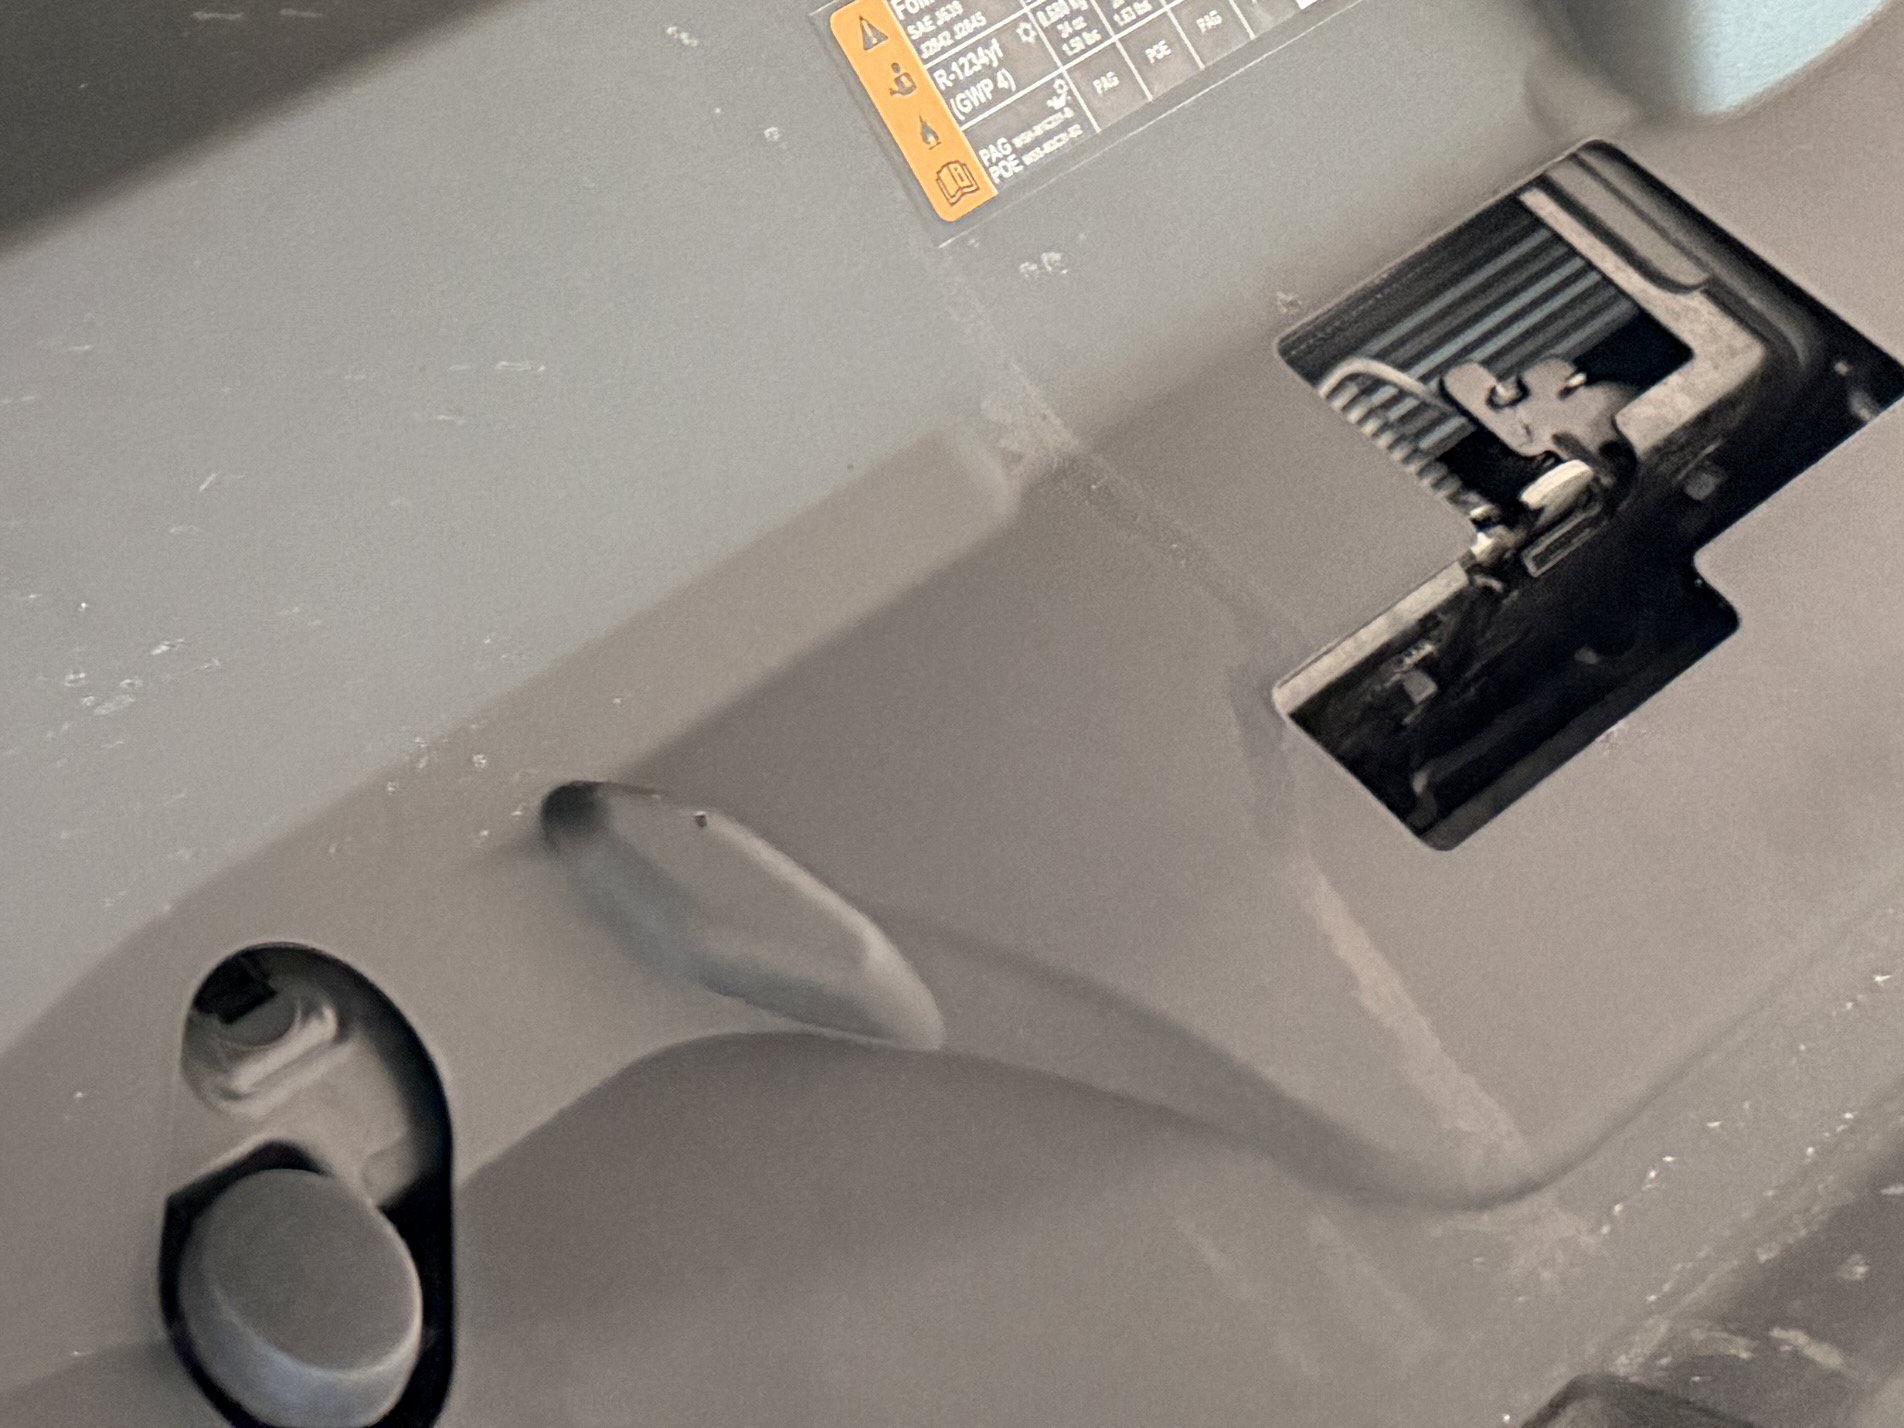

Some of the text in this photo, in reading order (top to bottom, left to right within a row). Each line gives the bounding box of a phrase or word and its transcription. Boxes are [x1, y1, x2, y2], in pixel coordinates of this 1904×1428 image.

[906, 13, 936, 40] SAE
[1195, 9, 1222, 33] PAG
[932, 36, 1004, 91] R-1234yf
[1144, 38, 1172, 64] POE
[949, 67, 1016, 121] (GWP 4)
[1091, 70, 1120, 95] PAG
[977, 136, 1013, 167] PAG
[987, 152, 1024, 184] POE
